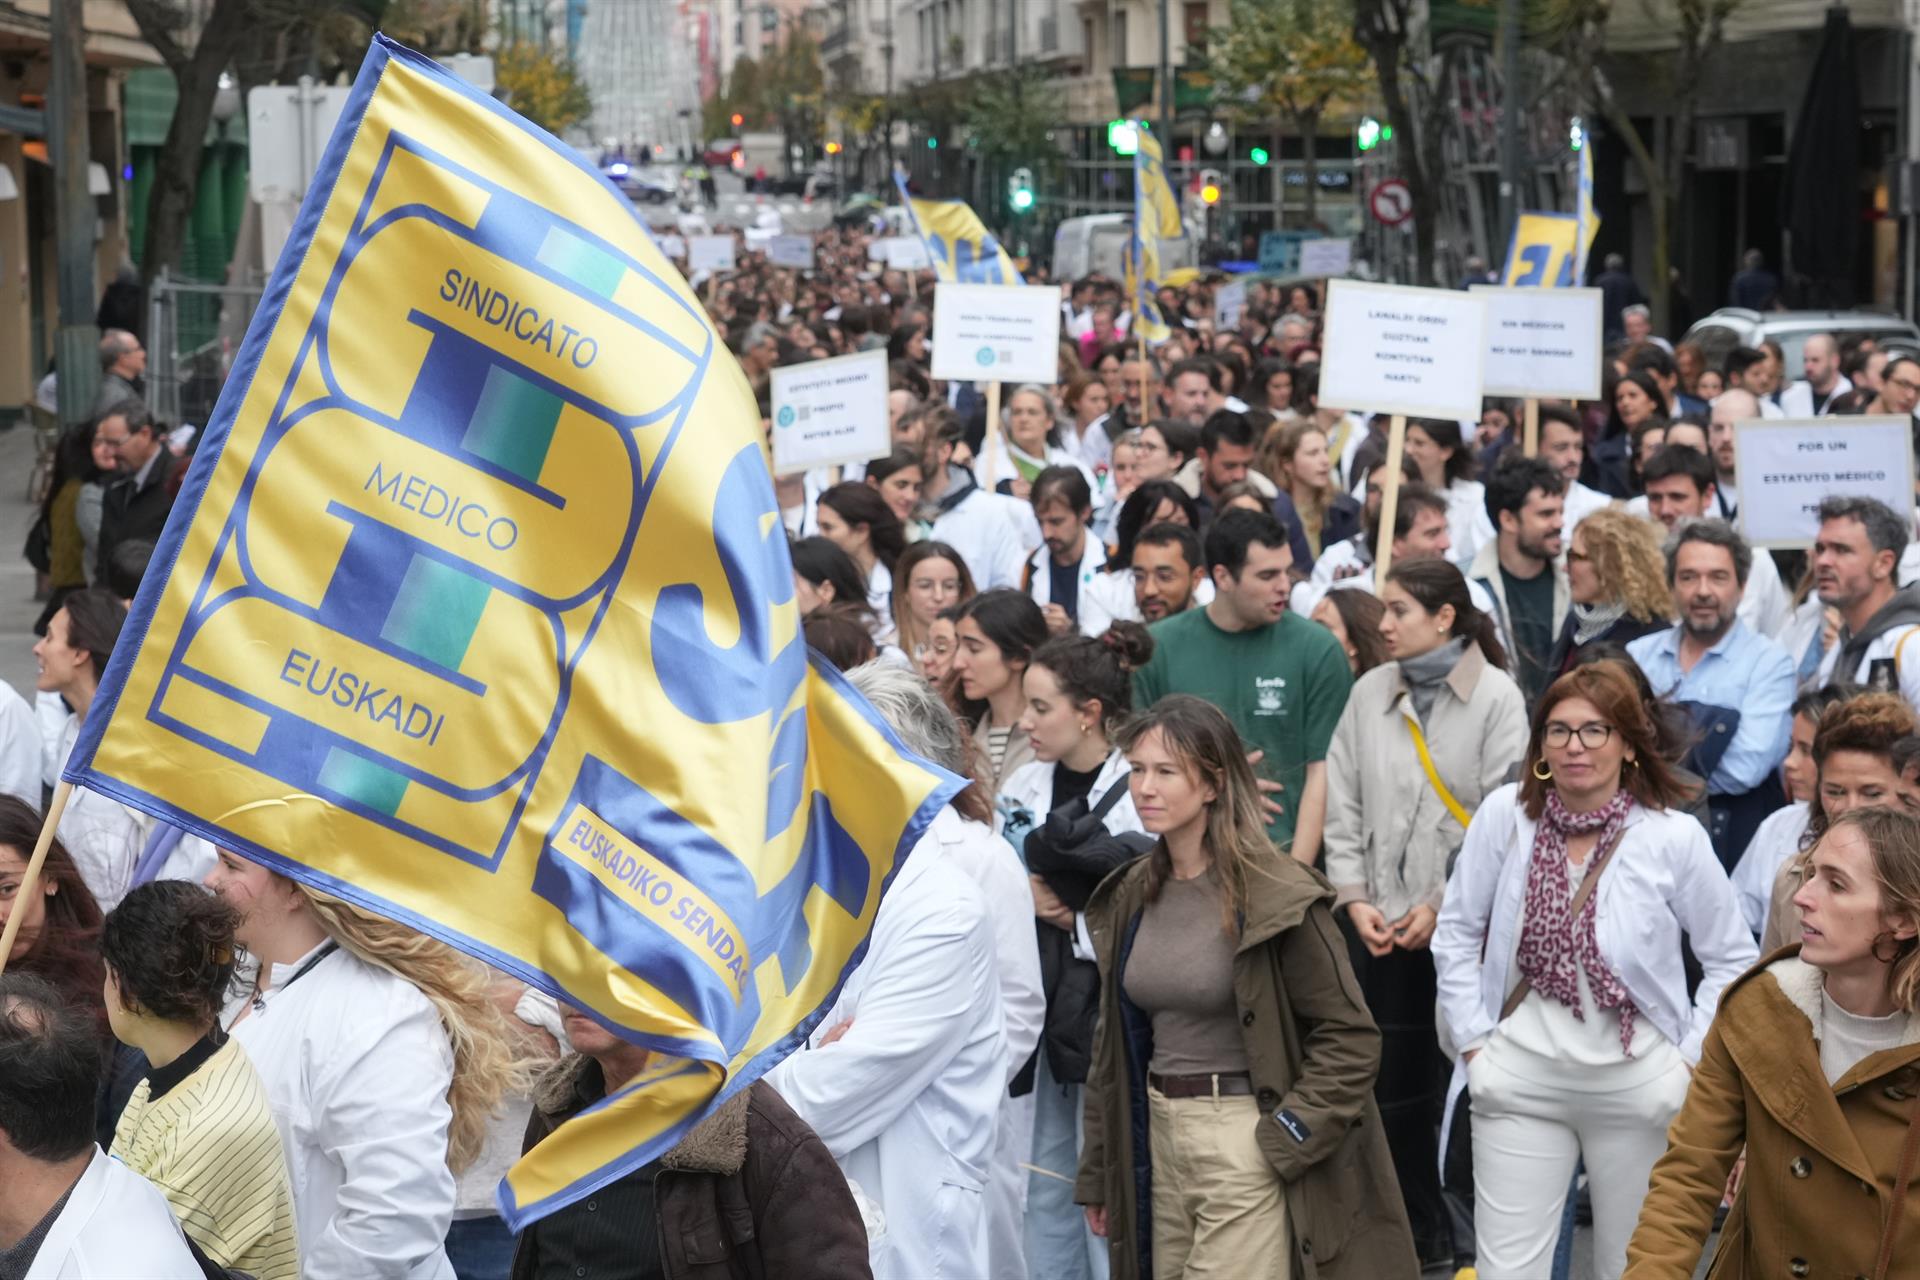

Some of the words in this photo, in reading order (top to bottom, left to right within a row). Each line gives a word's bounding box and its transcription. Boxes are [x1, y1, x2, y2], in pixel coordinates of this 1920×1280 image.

[440, 269, 598, 369] SINDICATO
[1763, 472, 1830, 484] ESTATUTO
[1798, 441, 1824, 451] POR
[1828, 441, 1848, 451] UN
[364, 462, 518, 551] MEDICO
[280, 648, 445, 747] EUSKADI
[568, 820, 673, 906] EUSKADIKO
